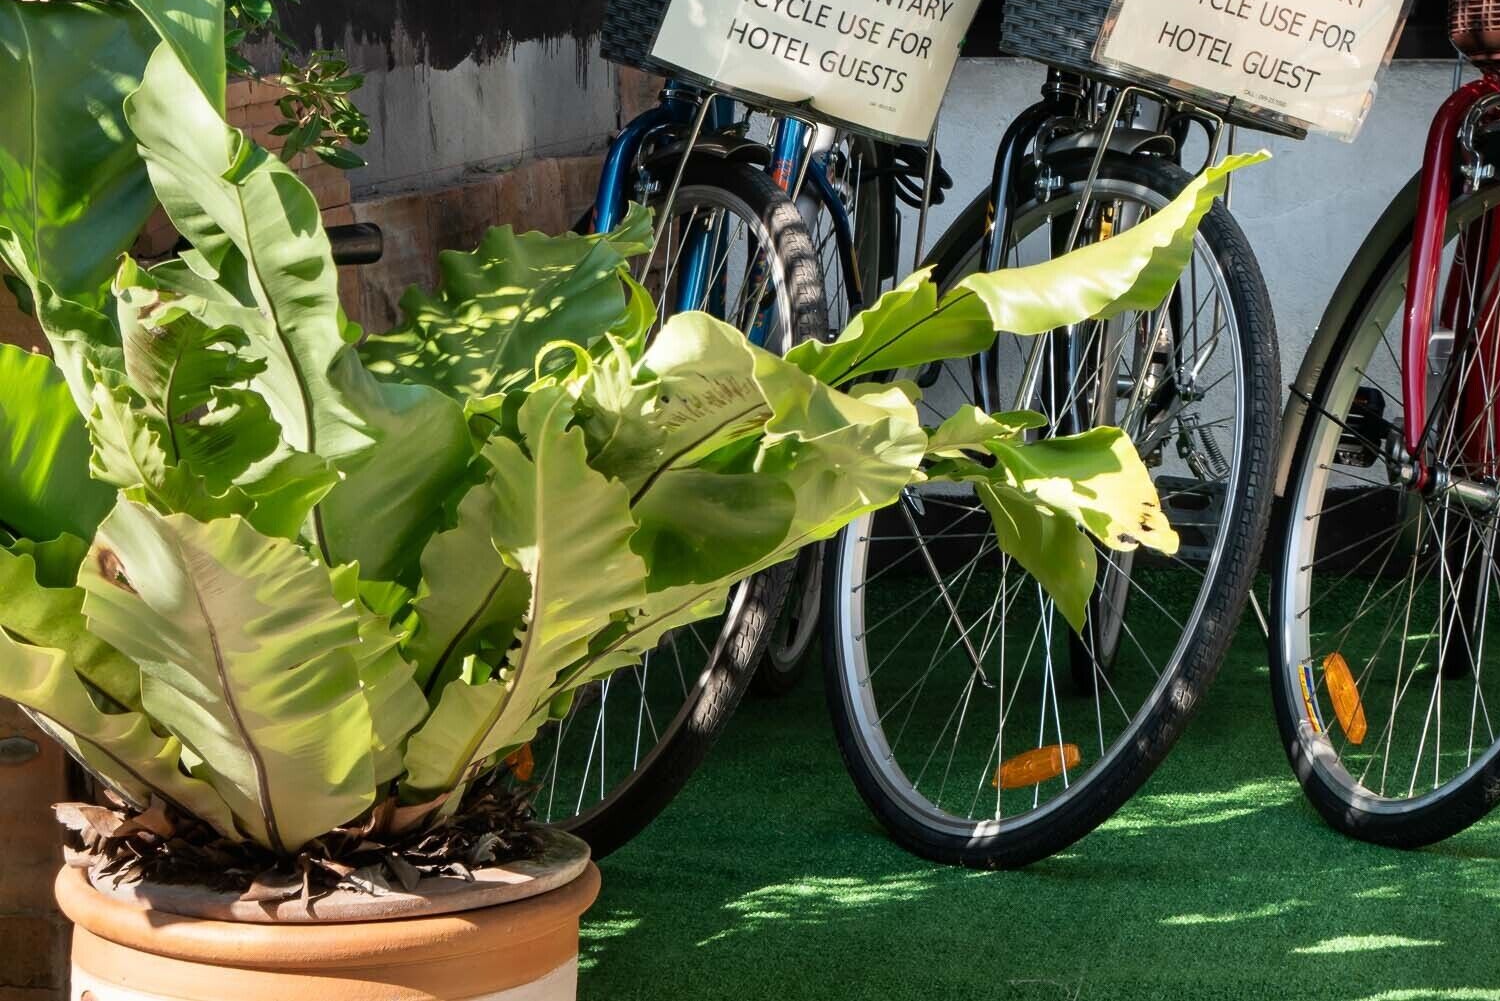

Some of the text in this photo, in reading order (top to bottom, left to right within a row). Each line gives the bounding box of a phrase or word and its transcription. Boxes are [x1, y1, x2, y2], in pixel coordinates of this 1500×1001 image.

[726, 17, 908, 94] HOTEL GUESTS
[837, 10, 883, 45] USE
[888, 27, 933, 59] FOR
[1157, 21, 1321, 93] HOTEL GUEST
[1259, 1, 1306, 37] USE
[1309, 19, 1357, 54] FOR
